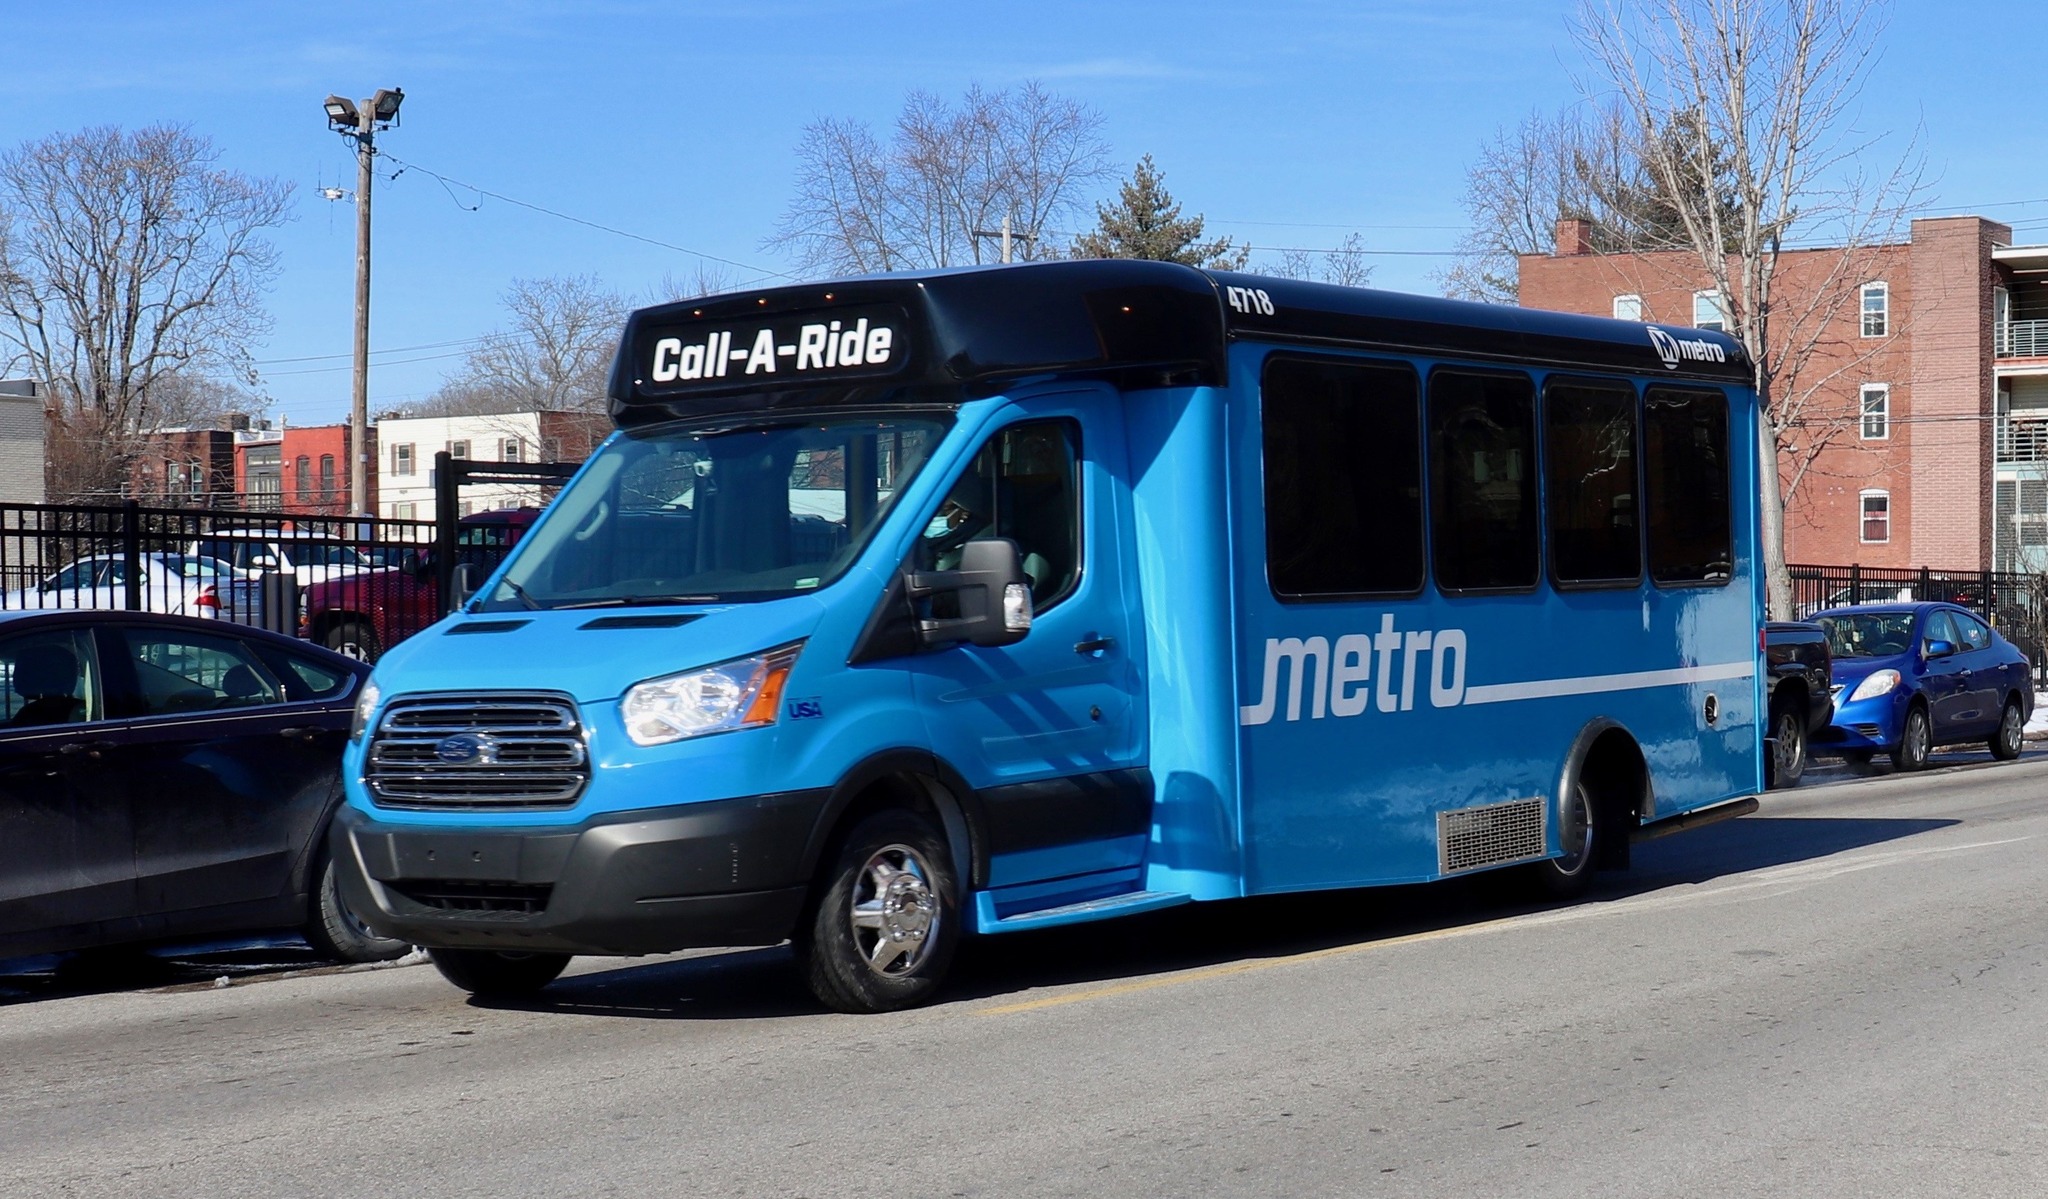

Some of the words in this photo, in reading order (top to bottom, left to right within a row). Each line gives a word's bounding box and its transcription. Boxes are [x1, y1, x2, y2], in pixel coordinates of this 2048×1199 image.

[1226, 286, 1275, 316] 4718
[652, 318, 893, 382] Call-A-Ride
[1678, 339, 1726, 363] metro
[1240, 613, 1467, 726] metro
[788, 701, 823, 719] USA
